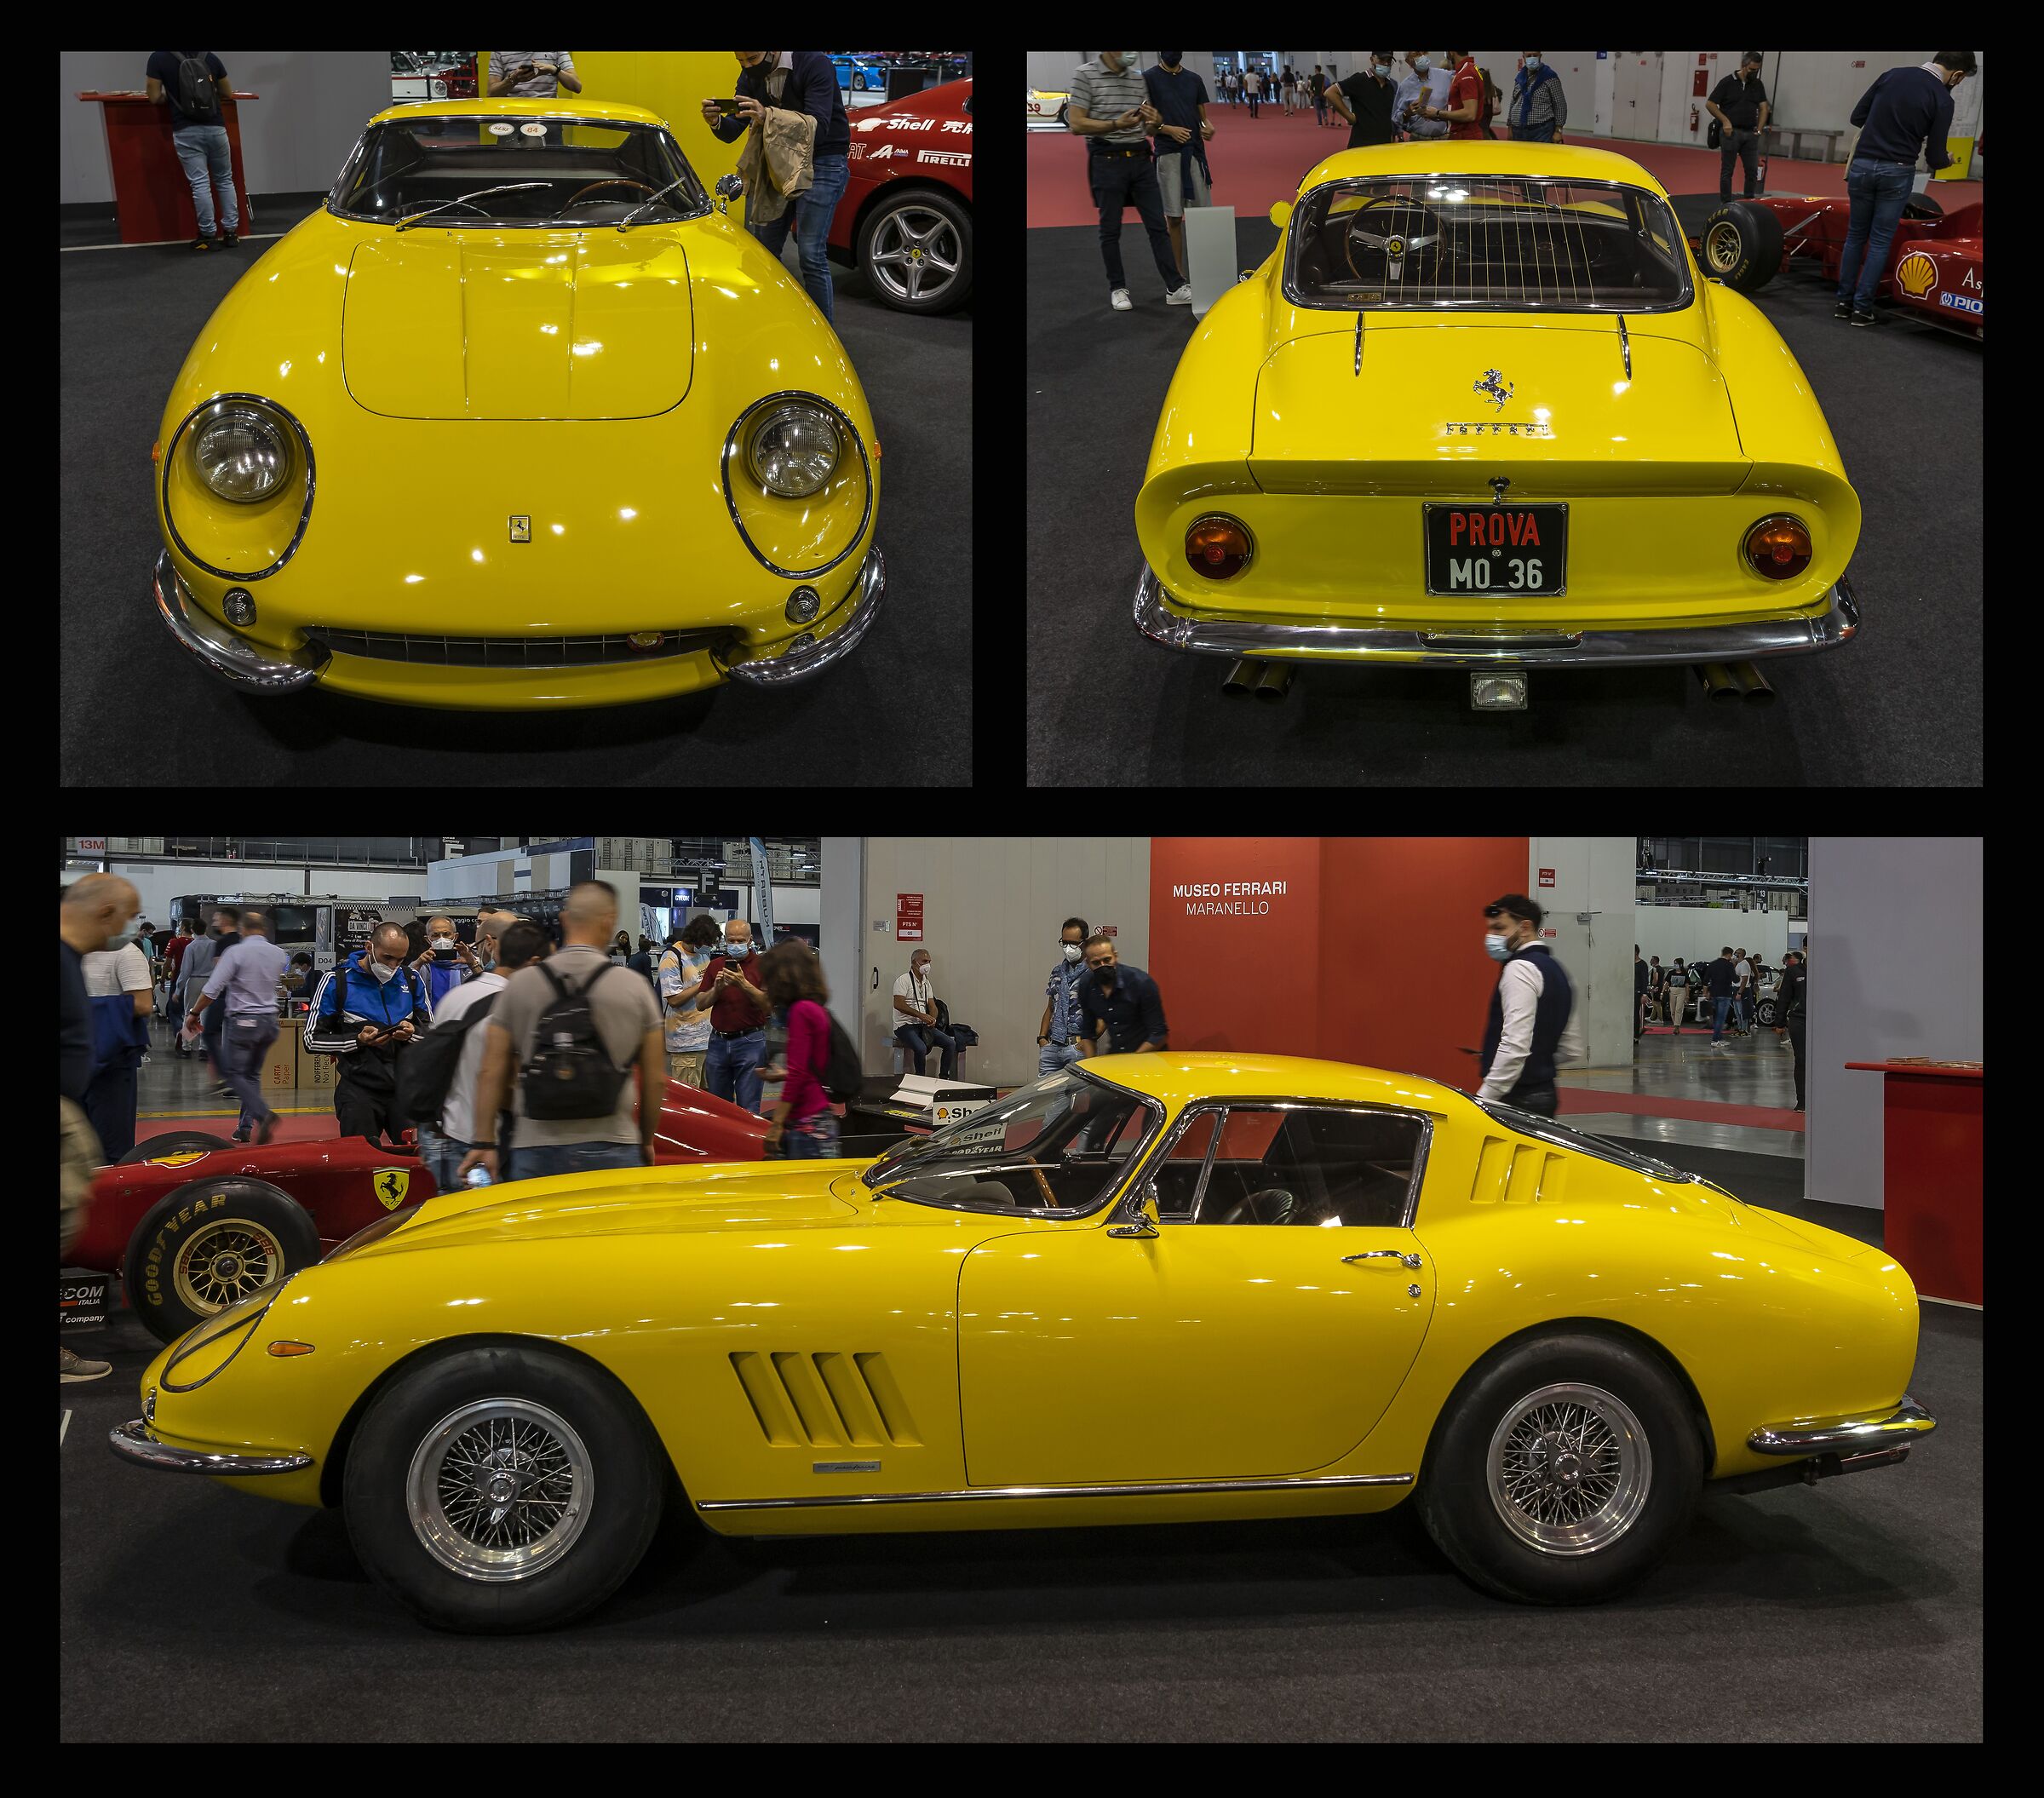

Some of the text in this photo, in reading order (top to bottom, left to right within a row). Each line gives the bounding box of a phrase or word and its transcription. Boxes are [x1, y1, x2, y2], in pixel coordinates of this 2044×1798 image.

[887, 118, 935, 130] Shell
[848, 142, 867, 159] AT
[916, 150, 973, 167] PIRELLI
[1961, 267, 1983, 298] As
[1450, 513, 1541, 546] PROVA
[1450, 558, 1543, 589] MO 36
[78, 840, 105, 850] 13M
[702, 874, 715, 893] F
[1173, 881, 1287, 898] MUSEO FERRARI
[1186, 901, 1269, 916] MARANELLO
[282, 1064, 291, 1084] Paper
[963, 1127, 1002, 1142] Shell
[145, 1193, 227, 1307] GOODYEAR
[253, 1232, 274, 1256] BBS
[179, 1245, 194, 1274] BBS
[60, 1285, 104, 1300] COM
[66, 1315, 105, 1324] company
